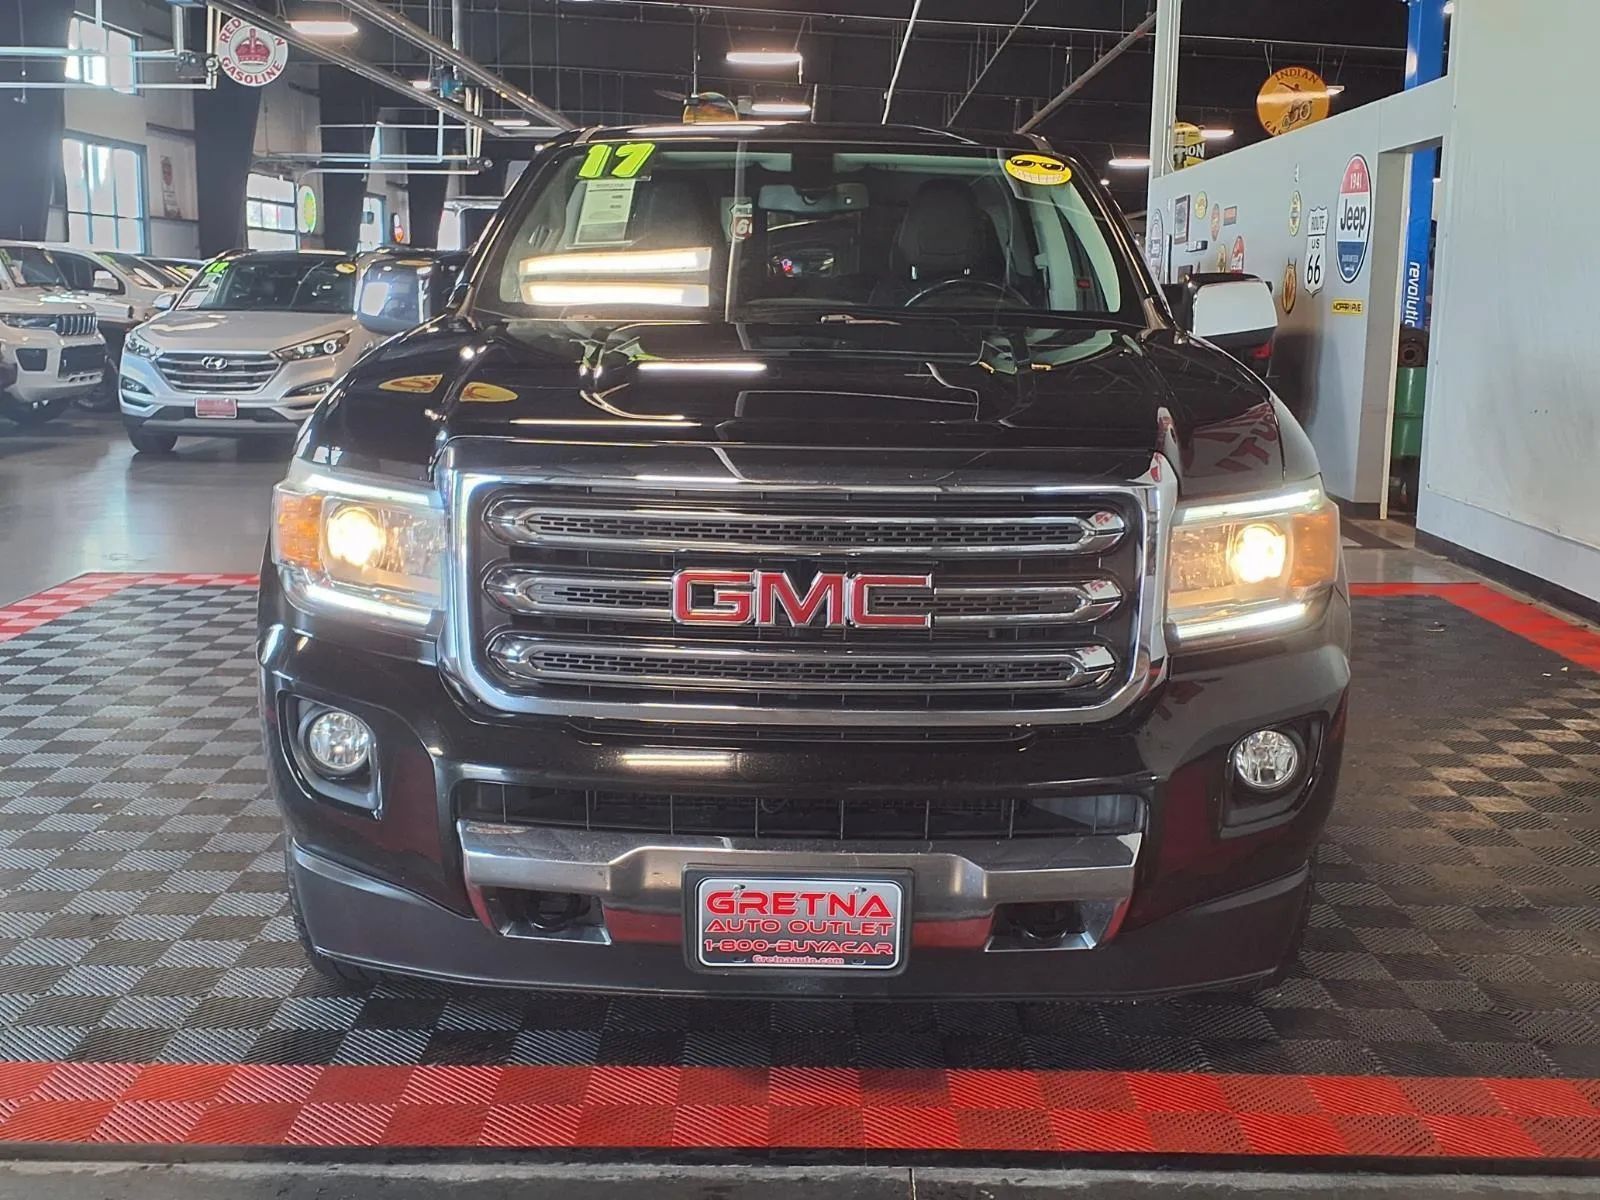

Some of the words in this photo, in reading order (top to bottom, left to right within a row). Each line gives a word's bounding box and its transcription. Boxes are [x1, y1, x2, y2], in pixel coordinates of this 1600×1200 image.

[219, 18, 242, 44] RED
[222, 56, 283, 84] GASOLINE
[1275, 68, 1319, 85] INDIAN
[578, 141, 656, 179] 17
[1349, 171, 1363, 190] 1941
[1310, 214, 1325, 231] ROUTE
[1339, 198, 1367, 238] Jeep
[1311, 238, 1320, 250] US
[1306, 253, 1321, 285] 66
[672, 568, 933, 628] GMC
[706, 889, 894, 919] GRETNA
[704, 919, 782, 934] AUTO
[787, 920, 895, 936] OUTLET
[704, 938, 894, 955] 1-800-BUYACAR
[752, 954, 845, 965] Gretnaauto.com
